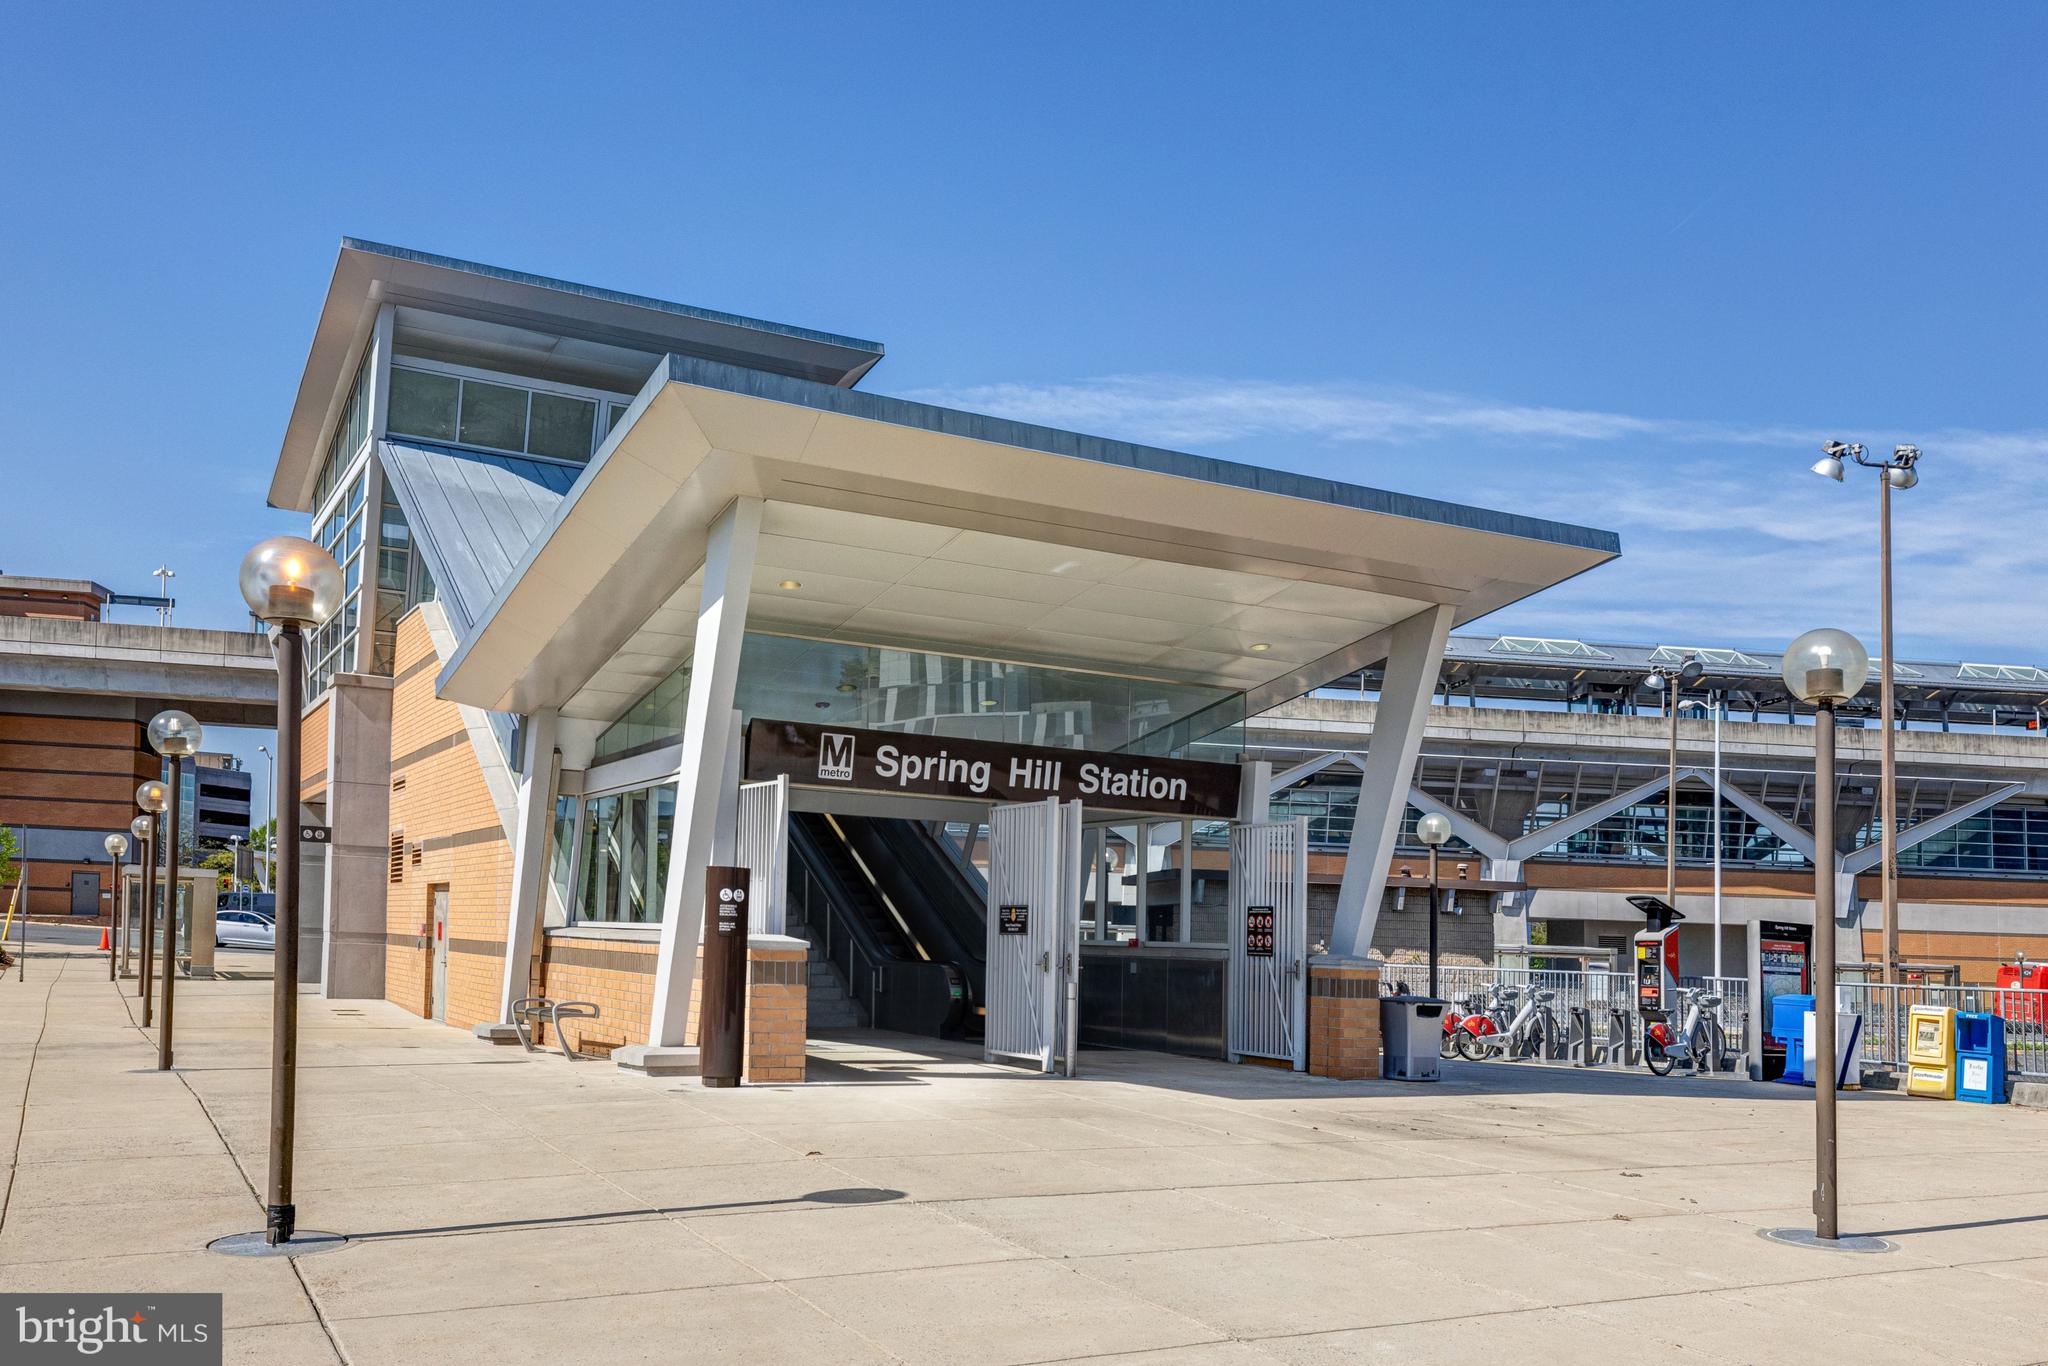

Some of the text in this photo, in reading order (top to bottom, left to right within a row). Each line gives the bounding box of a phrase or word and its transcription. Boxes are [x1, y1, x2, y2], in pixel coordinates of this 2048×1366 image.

[821, 735, 853, 768] M
[820, 768, 850, 778] metro
[875, 745, 1188, 801] Spring Hill Station
